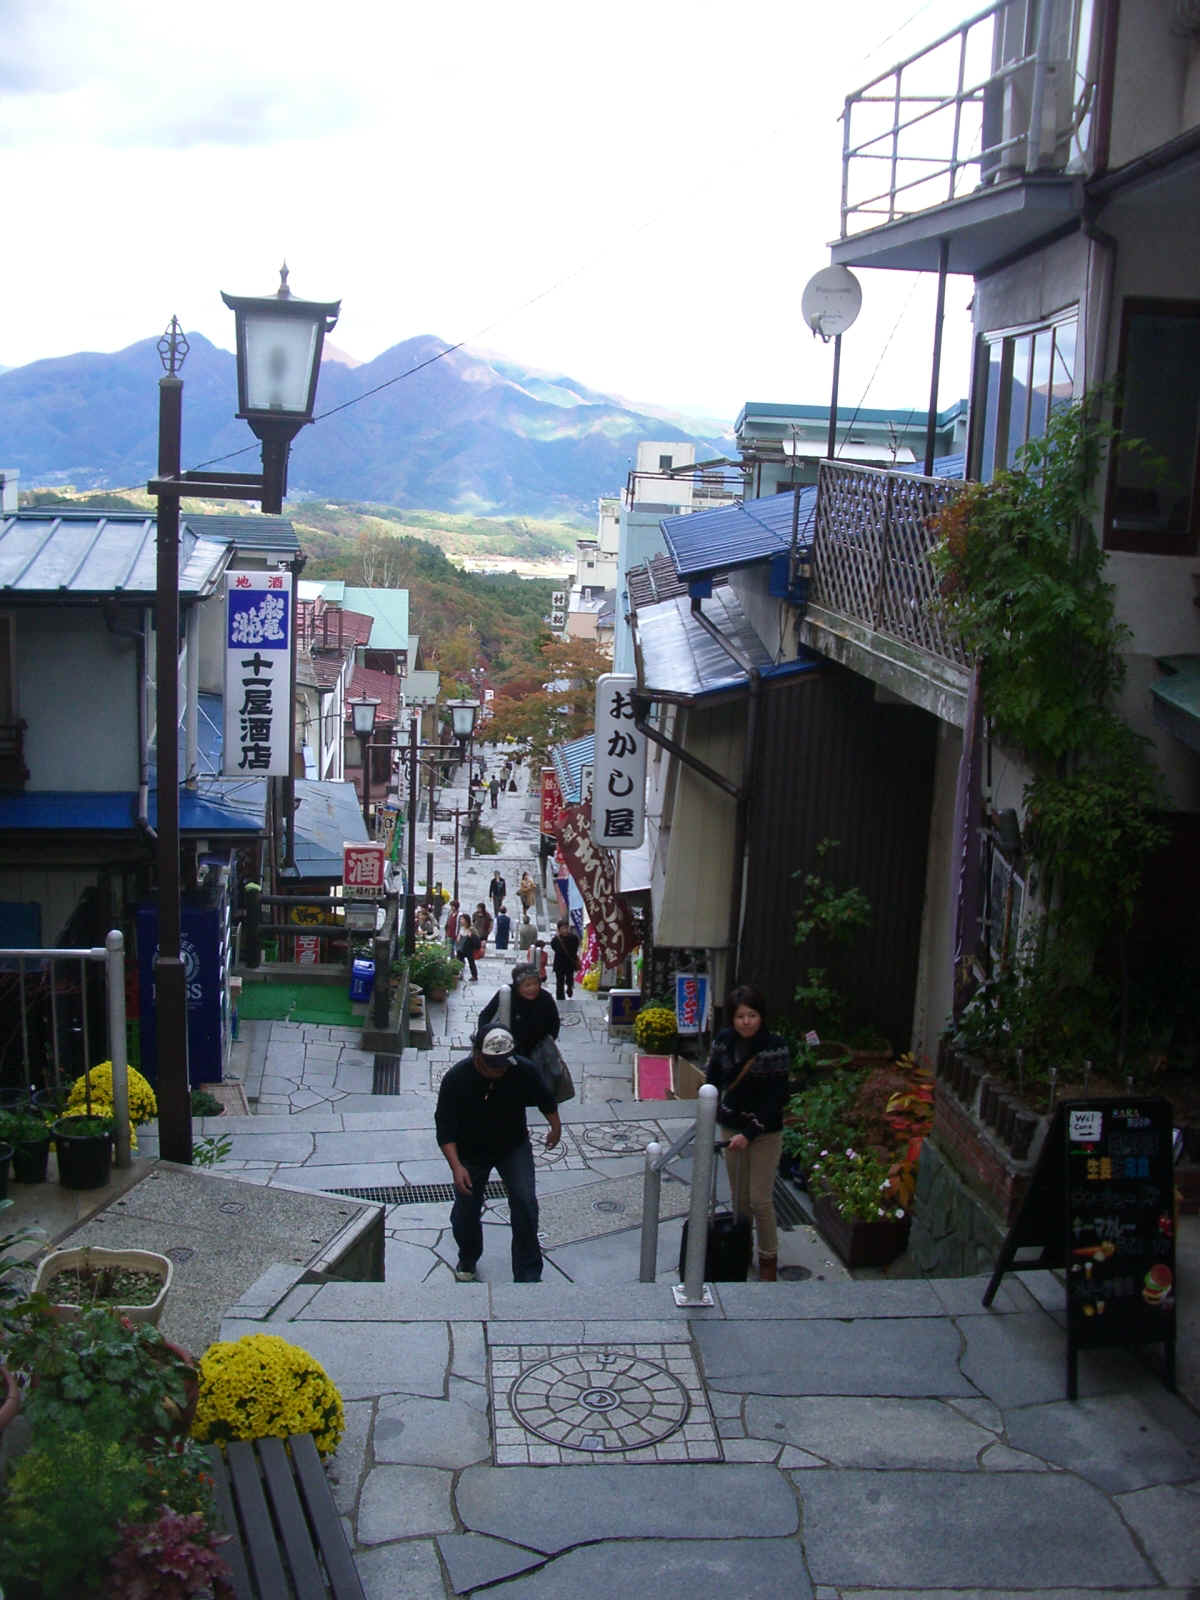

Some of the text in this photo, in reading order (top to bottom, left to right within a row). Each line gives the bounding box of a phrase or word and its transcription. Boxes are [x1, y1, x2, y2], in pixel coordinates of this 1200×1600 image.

[235, 575, 284, 589] 地酒
[238, 651, 274, 770] 十一屋酒店
[603, 691, 637, 838] おかし屋
[348, 852, 381, 884] 酒
